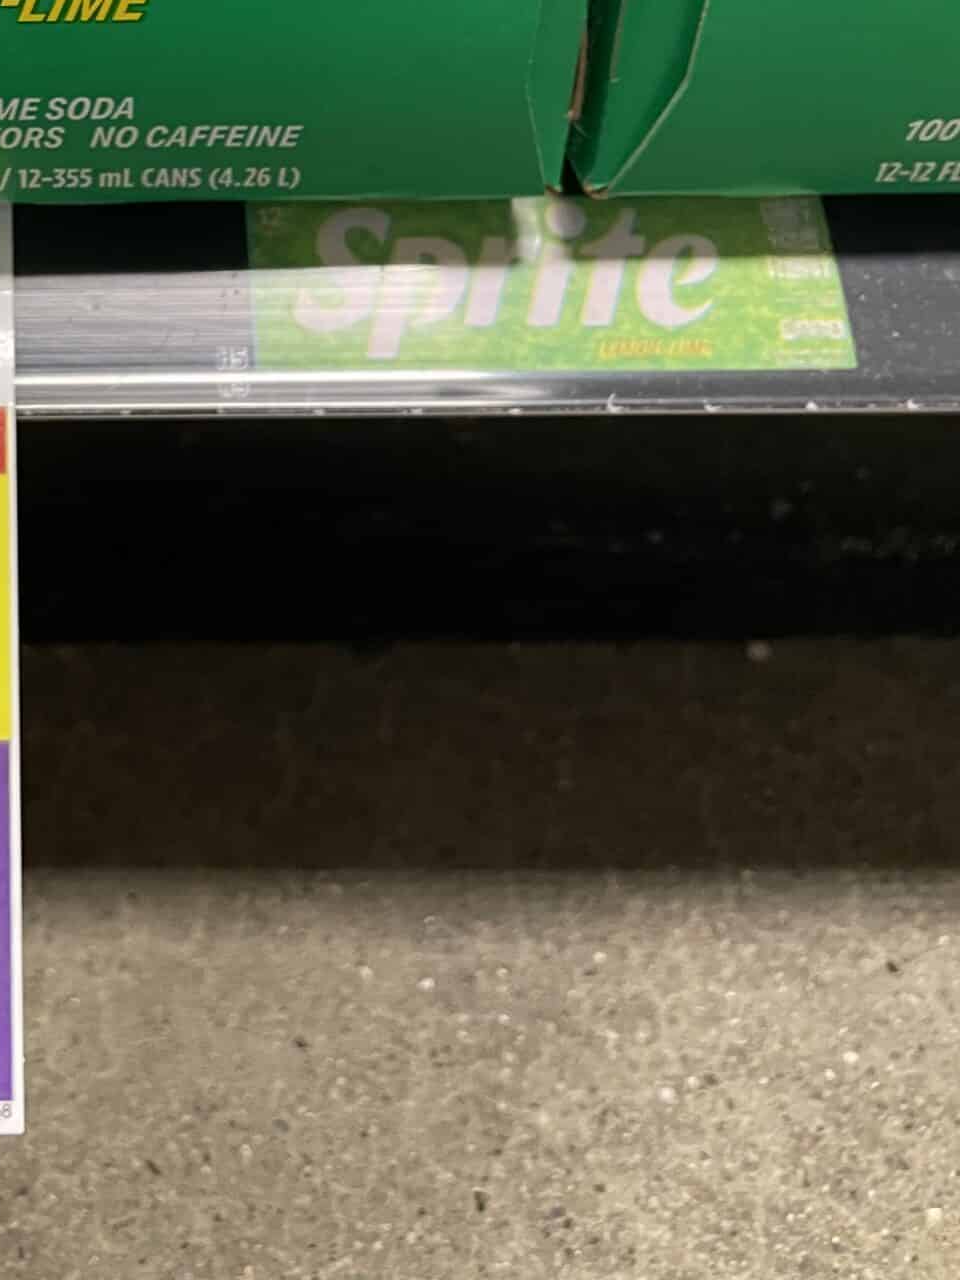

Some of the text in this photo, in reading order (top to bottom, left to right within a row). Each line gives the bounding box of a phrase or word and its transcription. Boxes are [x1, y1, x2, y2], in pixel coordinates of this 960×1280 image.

[44, 96, 135, 120] SODA
[90, 126, 138, 148] NO
[145, 124, 304, 148] CAFFEINE
[17, 169, 91, 189] 12-355
[98, 168, 134, 188] mL
[140, 167, 201, 188] CANS
[208, 167, 271, 190] (4.26
[277, 167, 301, 190] L)
[875, 161, 936, 182] 12-12
[293, 199, 718, 359] Sprite
